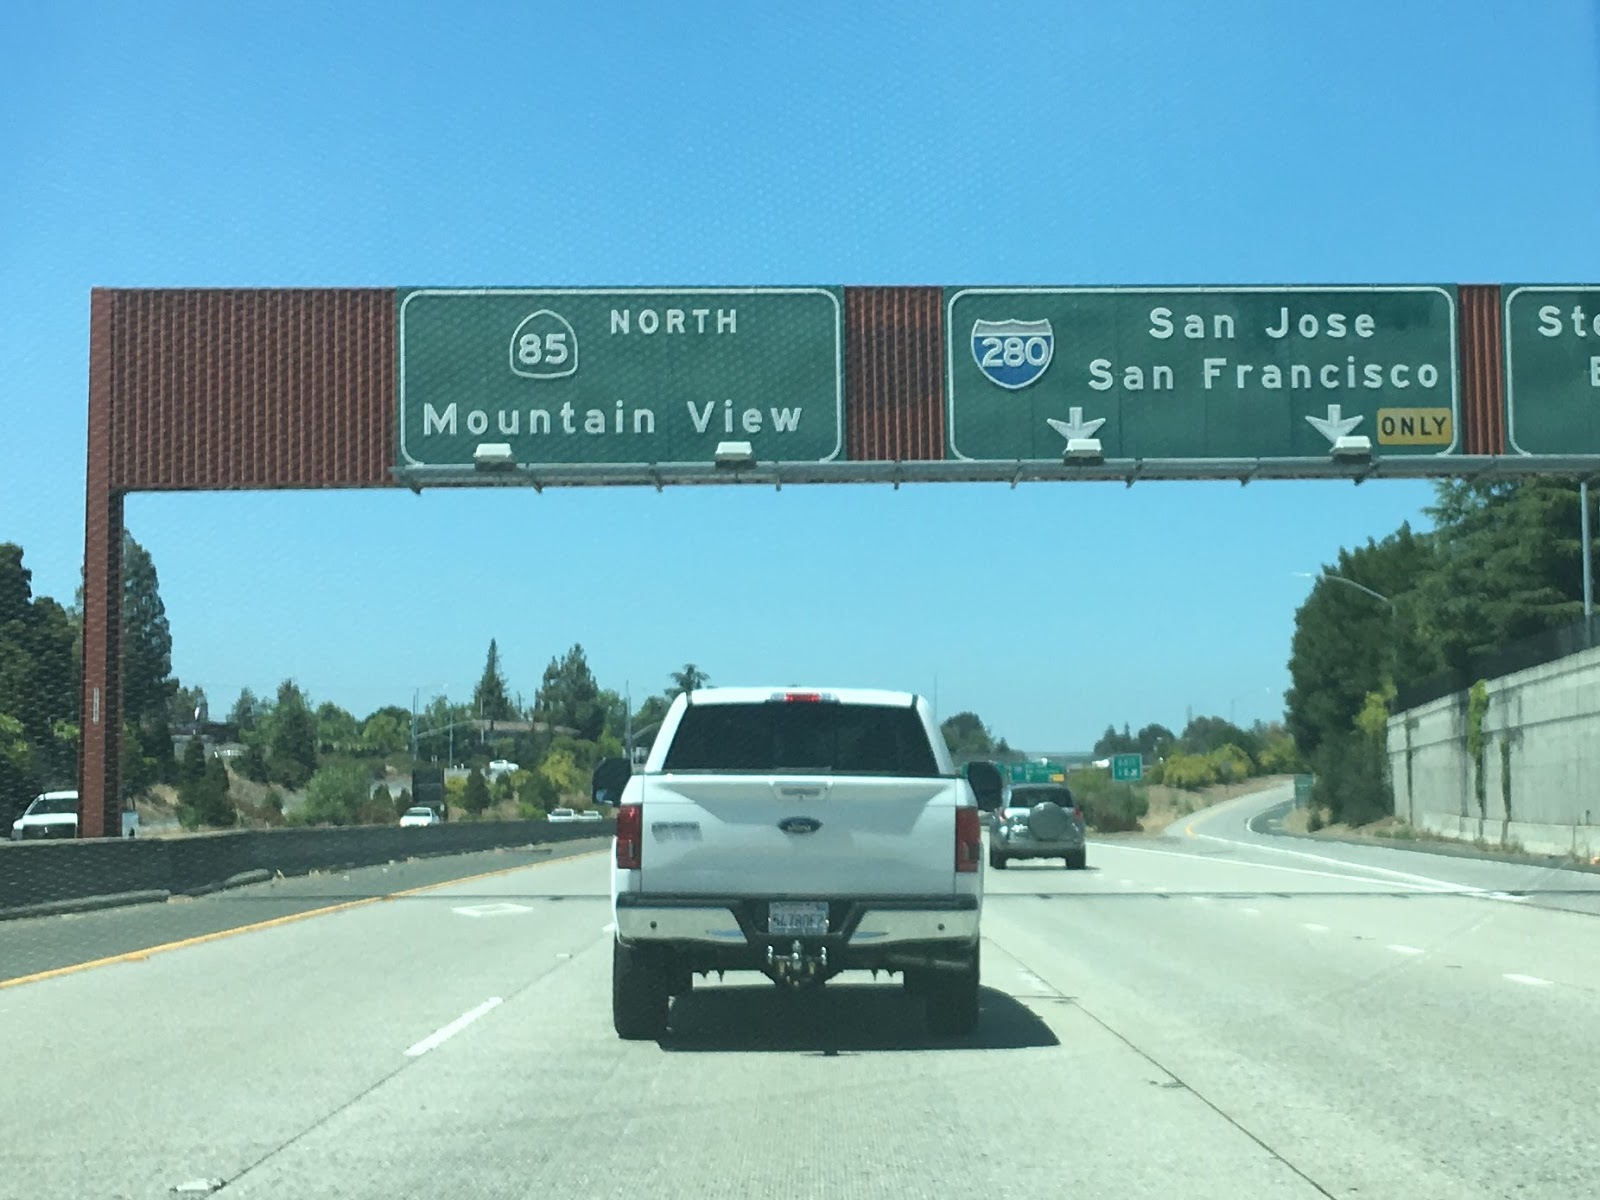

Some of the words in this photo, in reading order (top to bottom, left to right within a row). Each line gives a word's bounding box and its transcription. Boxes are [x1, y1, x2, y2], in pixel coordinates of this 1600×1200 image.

[611, 309, 736, 334] NORTH
[1149, 308, 1233, 338] San
[1266, 308, 1374, 338] Jose
[518, 333, 568, 364] 85
[982, 337, 1049, 367] 280
[1089, 359, 1172, 390] San
[1204, 356, 1437, 388] Francisco
[424, 400, 654, 434] Mountain
[688, 400, 801, 432] View
[1382, 417, 1446, 436] ONLY
